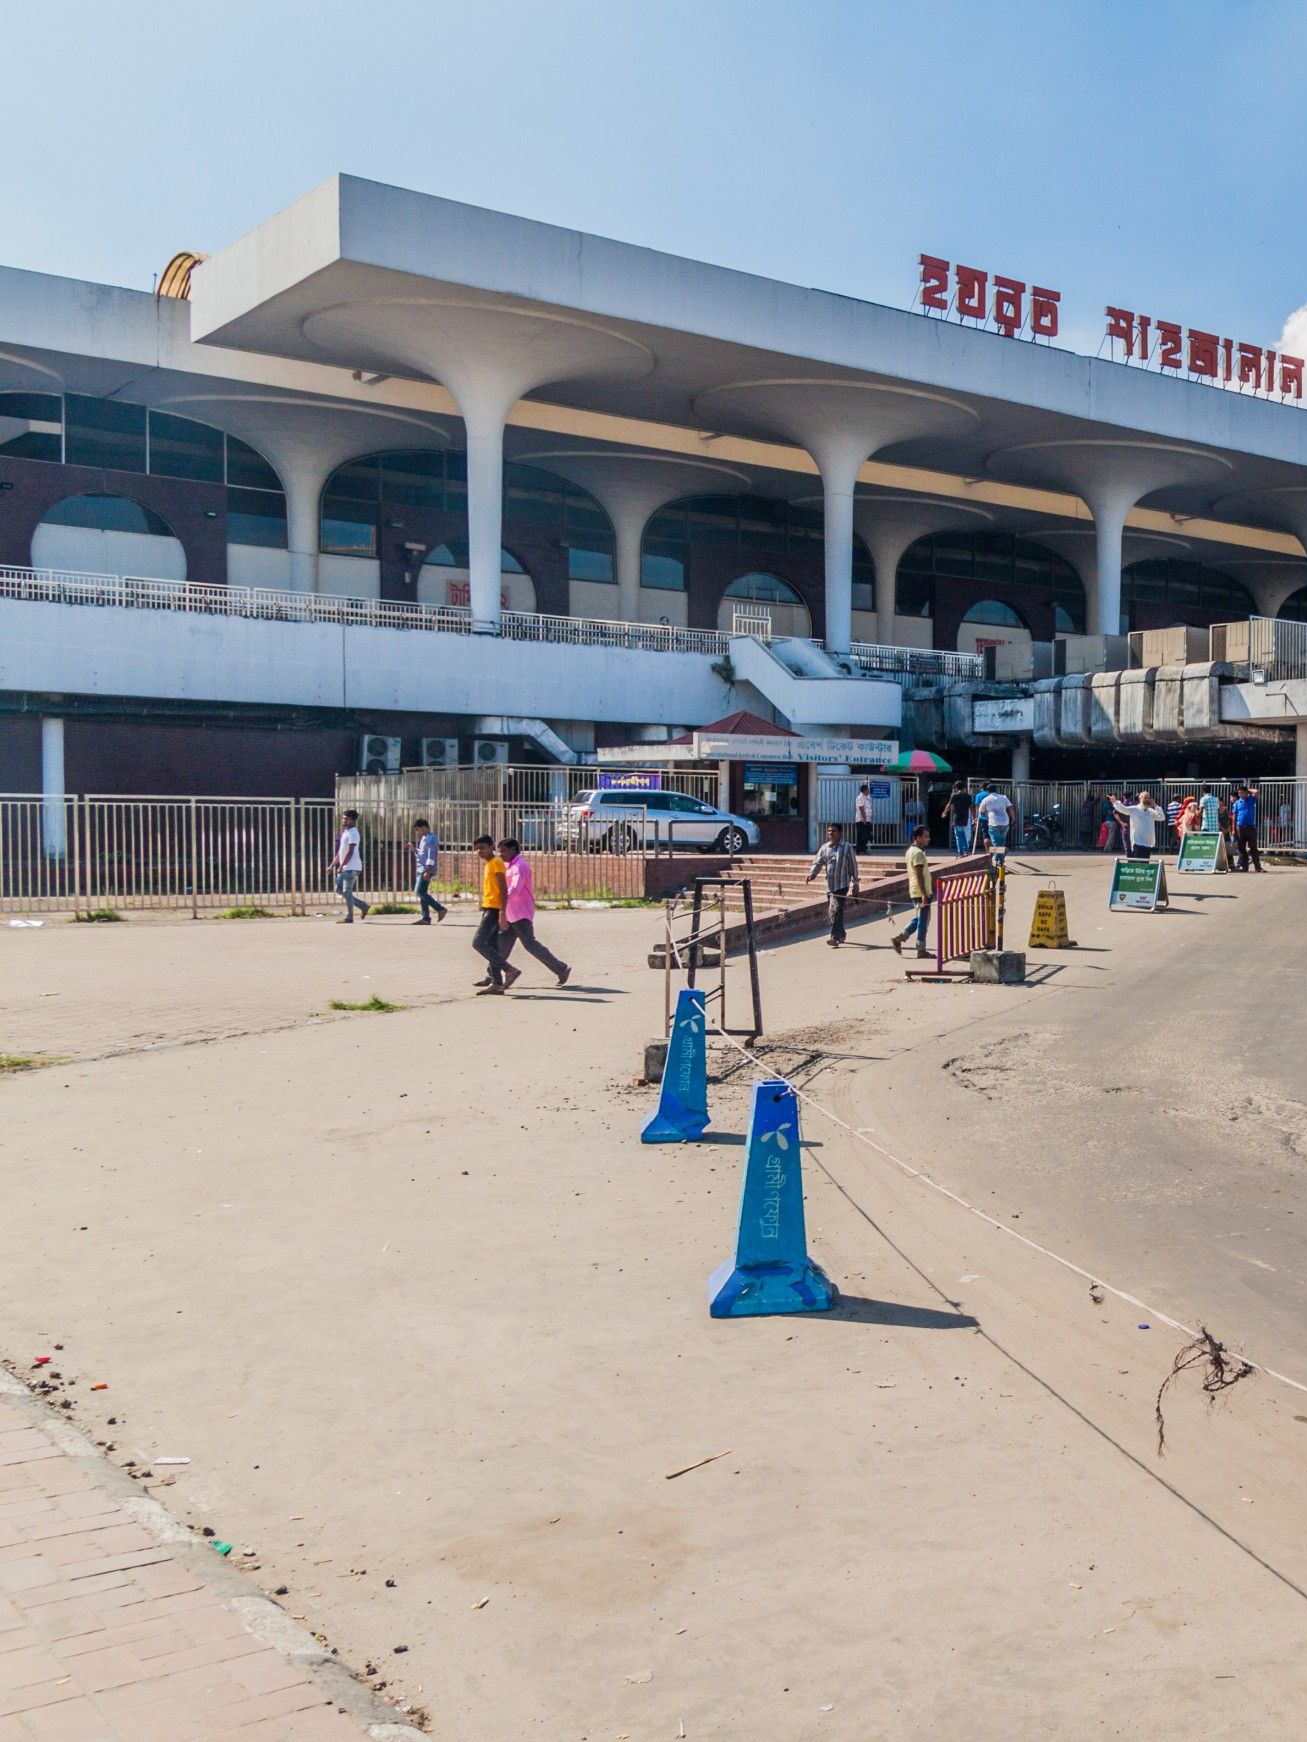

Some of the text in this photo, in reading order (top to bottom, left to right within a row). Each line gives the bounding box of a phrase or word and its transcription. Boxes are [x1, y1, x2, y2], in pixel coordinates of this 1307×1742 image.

[918, 253, 1061, 338] হযরত
[1105, 305, 1305, 399] শাহজালাল
[845, 754, 893, 764] Entrance
